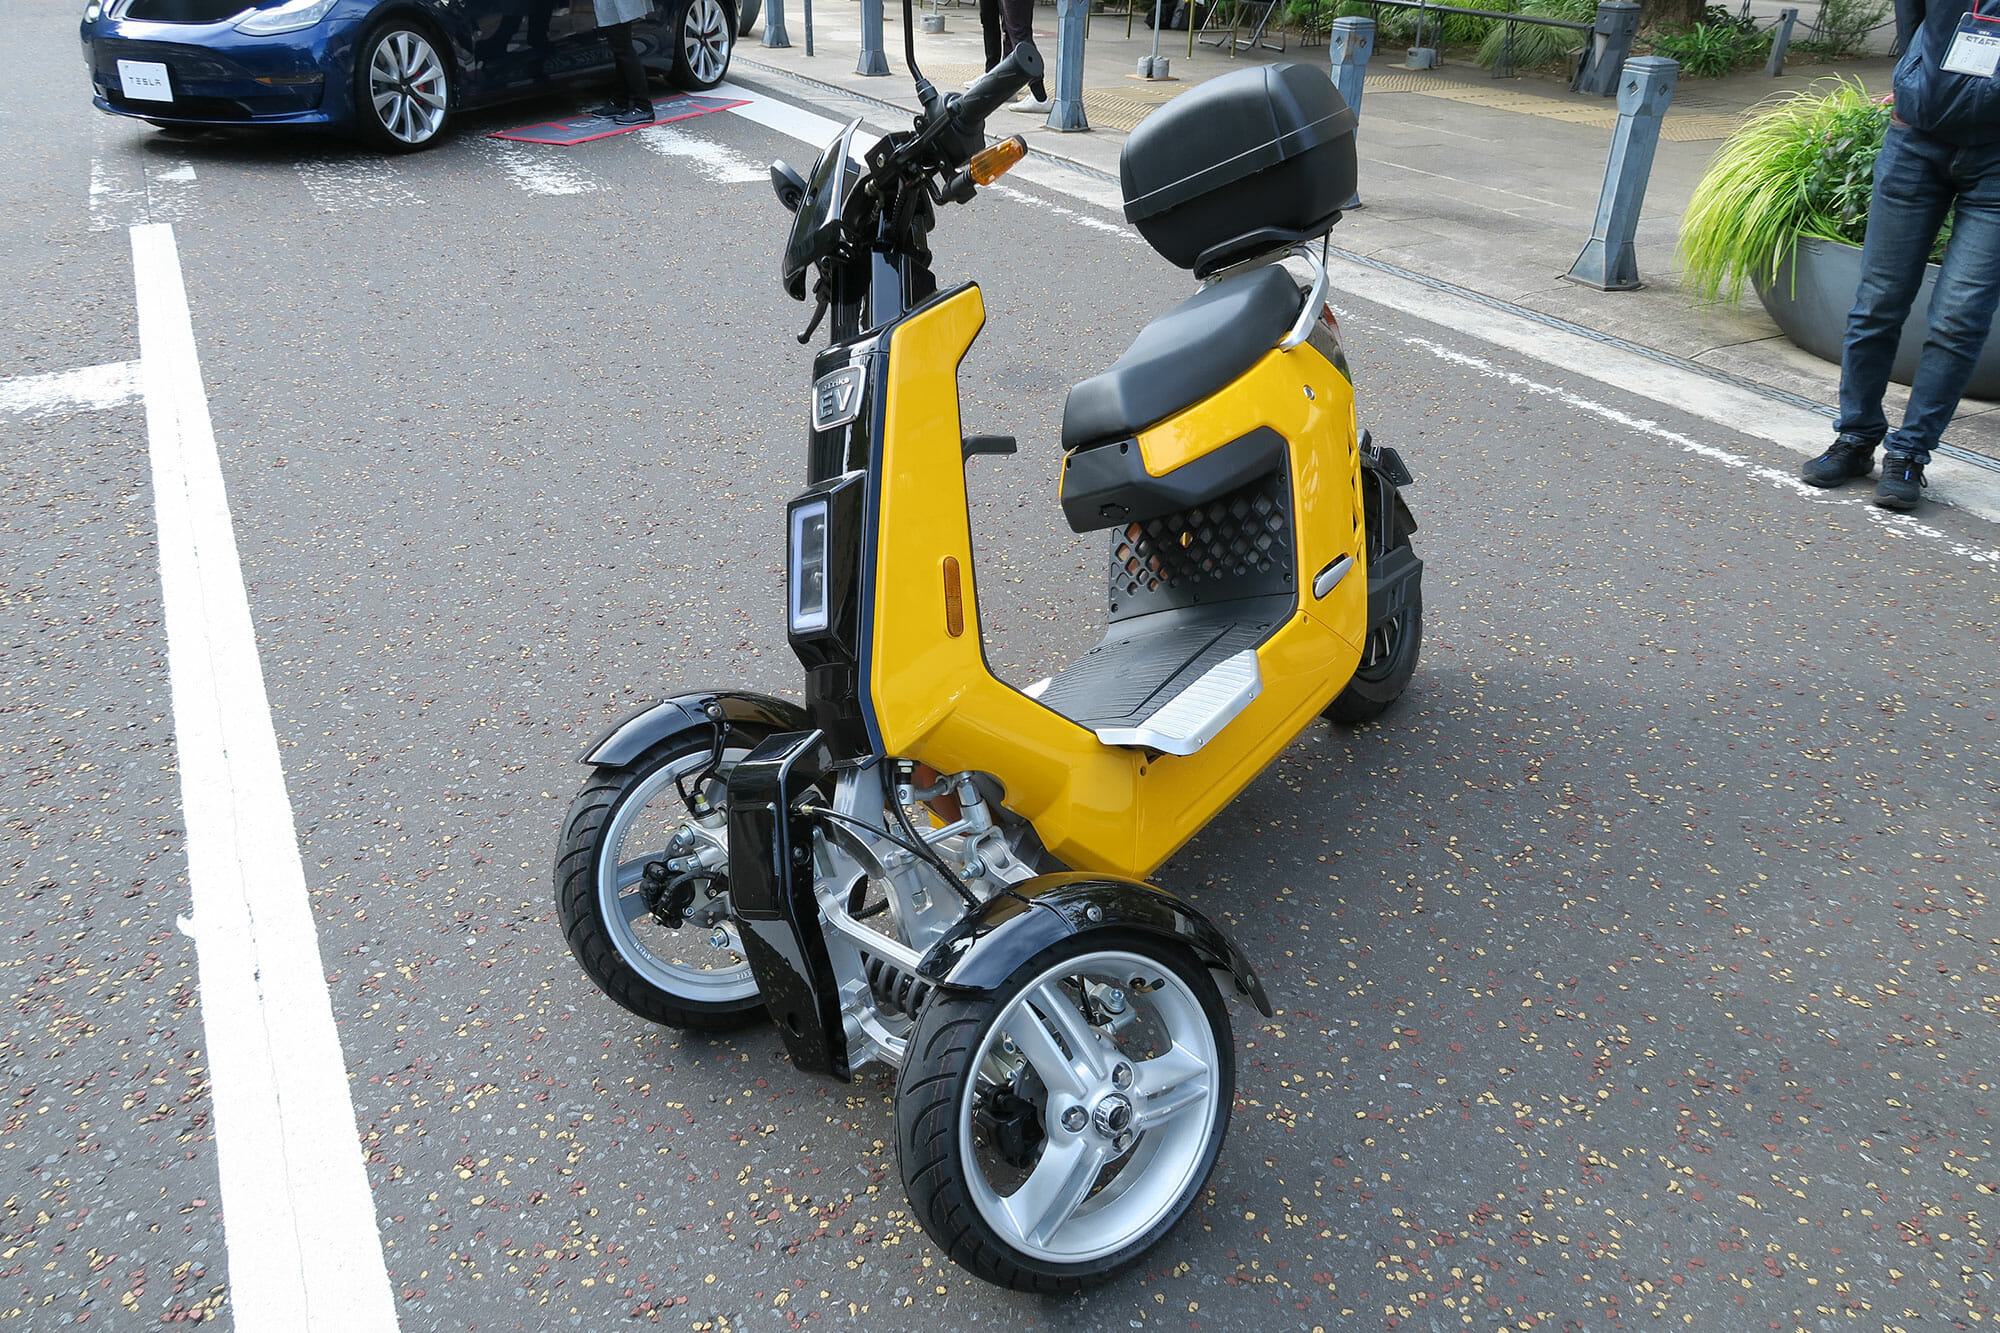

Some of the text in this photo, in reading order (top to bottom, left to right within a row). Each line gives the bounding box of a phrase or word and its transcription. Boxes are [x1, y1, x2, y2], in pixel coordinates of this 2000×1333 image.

[1966, 35, 1999, 46] STAFF
[128, 76, 162, 87] TESLA
[819, 384, 854, 420] EV
